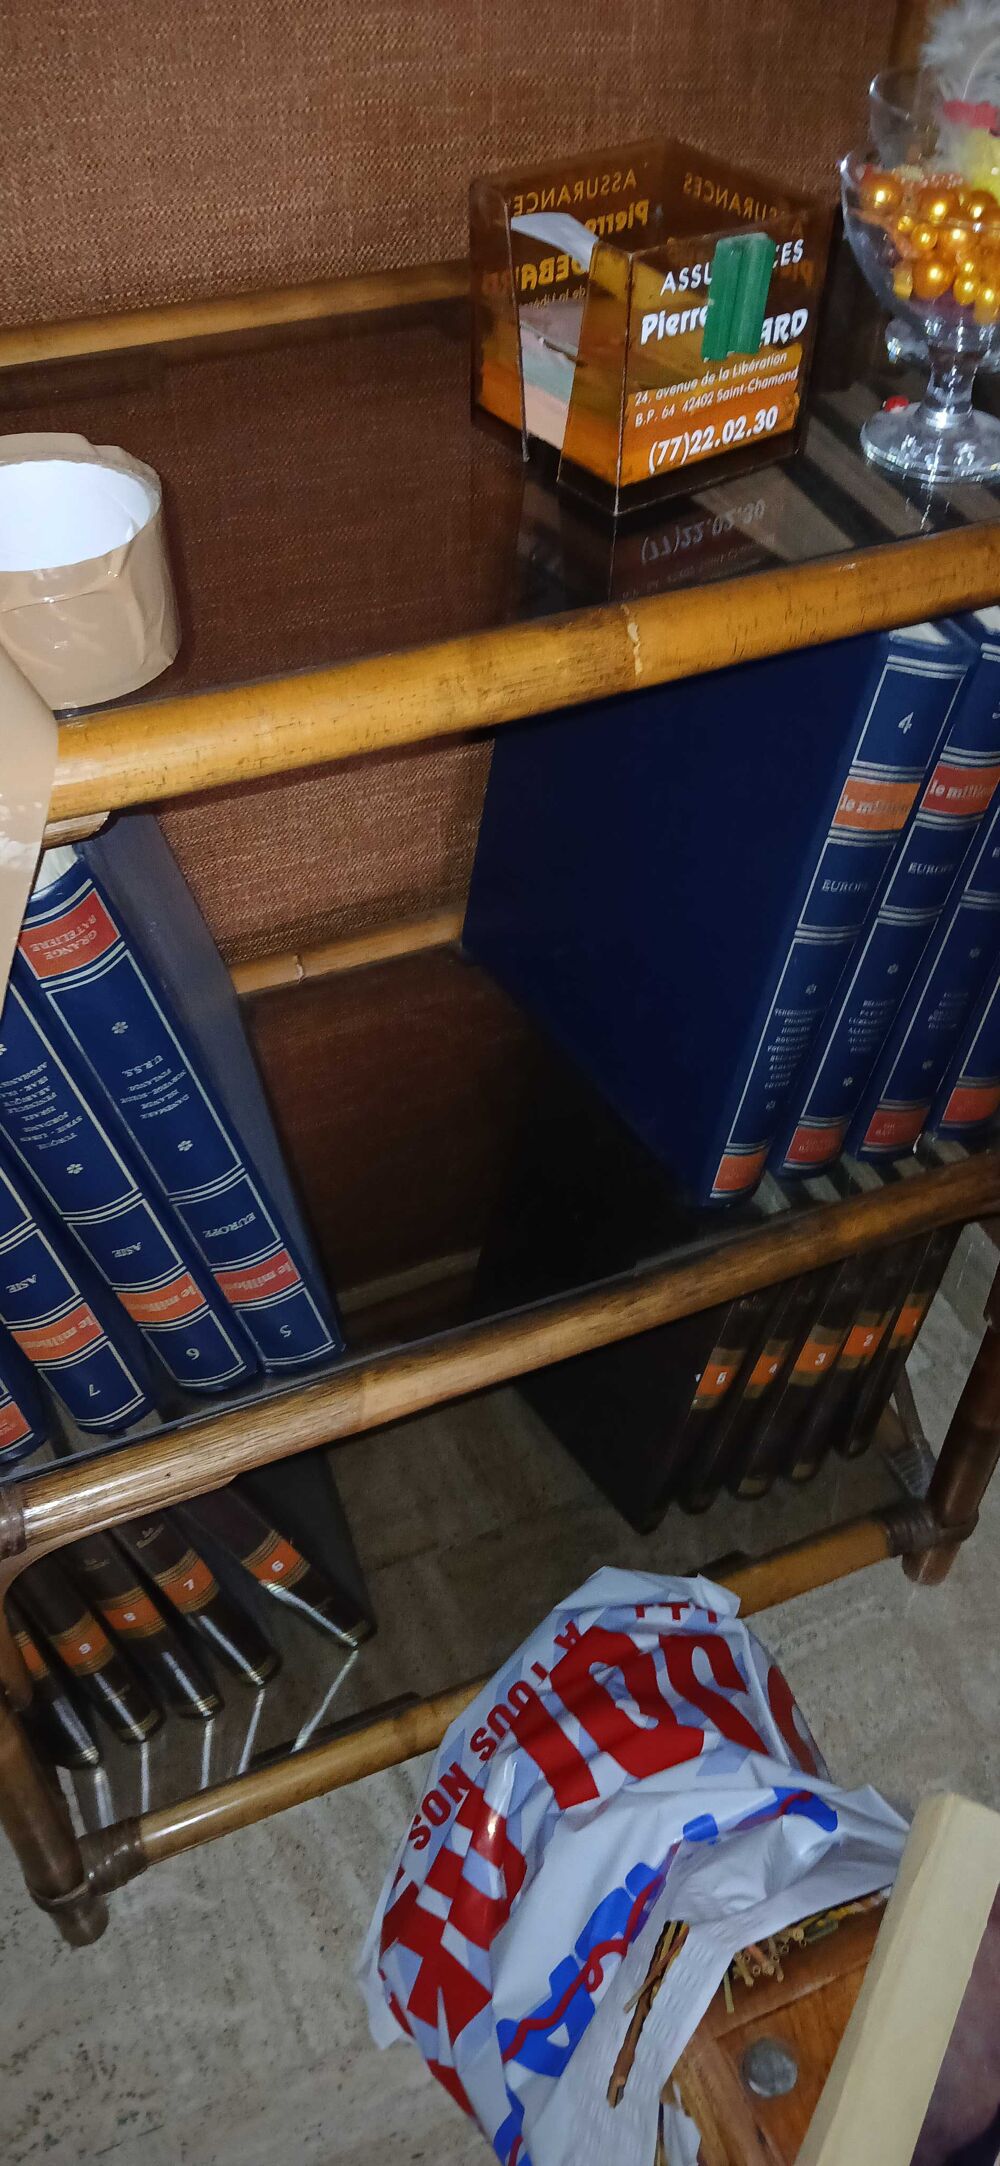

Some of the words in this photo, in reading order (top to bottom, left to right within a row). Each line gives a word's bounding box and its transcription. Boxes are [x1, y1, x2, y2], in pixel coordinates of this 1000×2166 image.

[656, 379, 698, 401] avenue
[701, 371, 715, 385] de
[718, 367, 729, 383] la
[733, 352, 788, 378] Libération
[635, 411, 657, 429] B.P.
[661, 406, 676, 419] 64
[716, 364, 799, 403] Saint-Chamond
[648, 405, 779, 474] (77)22.02.30
[898, 711, 915, 734] 4
[929, 779, 945, 796] le
[45, 929, 98, 961] GRANGE
[202, 1211, 257, 1239] EUROPE
[111, 1241, 142, 1258] ASIE
[276, 1261, 294, 1277] le
[5, 1273, 38, 1294] ASIE
[181, 1284, 198, 1299] le
[78, 1316, 95, 1333] le
[280, 1324, 292, 1338] 5
[186, 1347, 200, 1361] 6
[88, 1383, 101, 1397] 7
[271, 1560, 284, 1573] 6
[183, 1578, 195, 1590] 7
[408, 1762, 478, 1850] NOS
